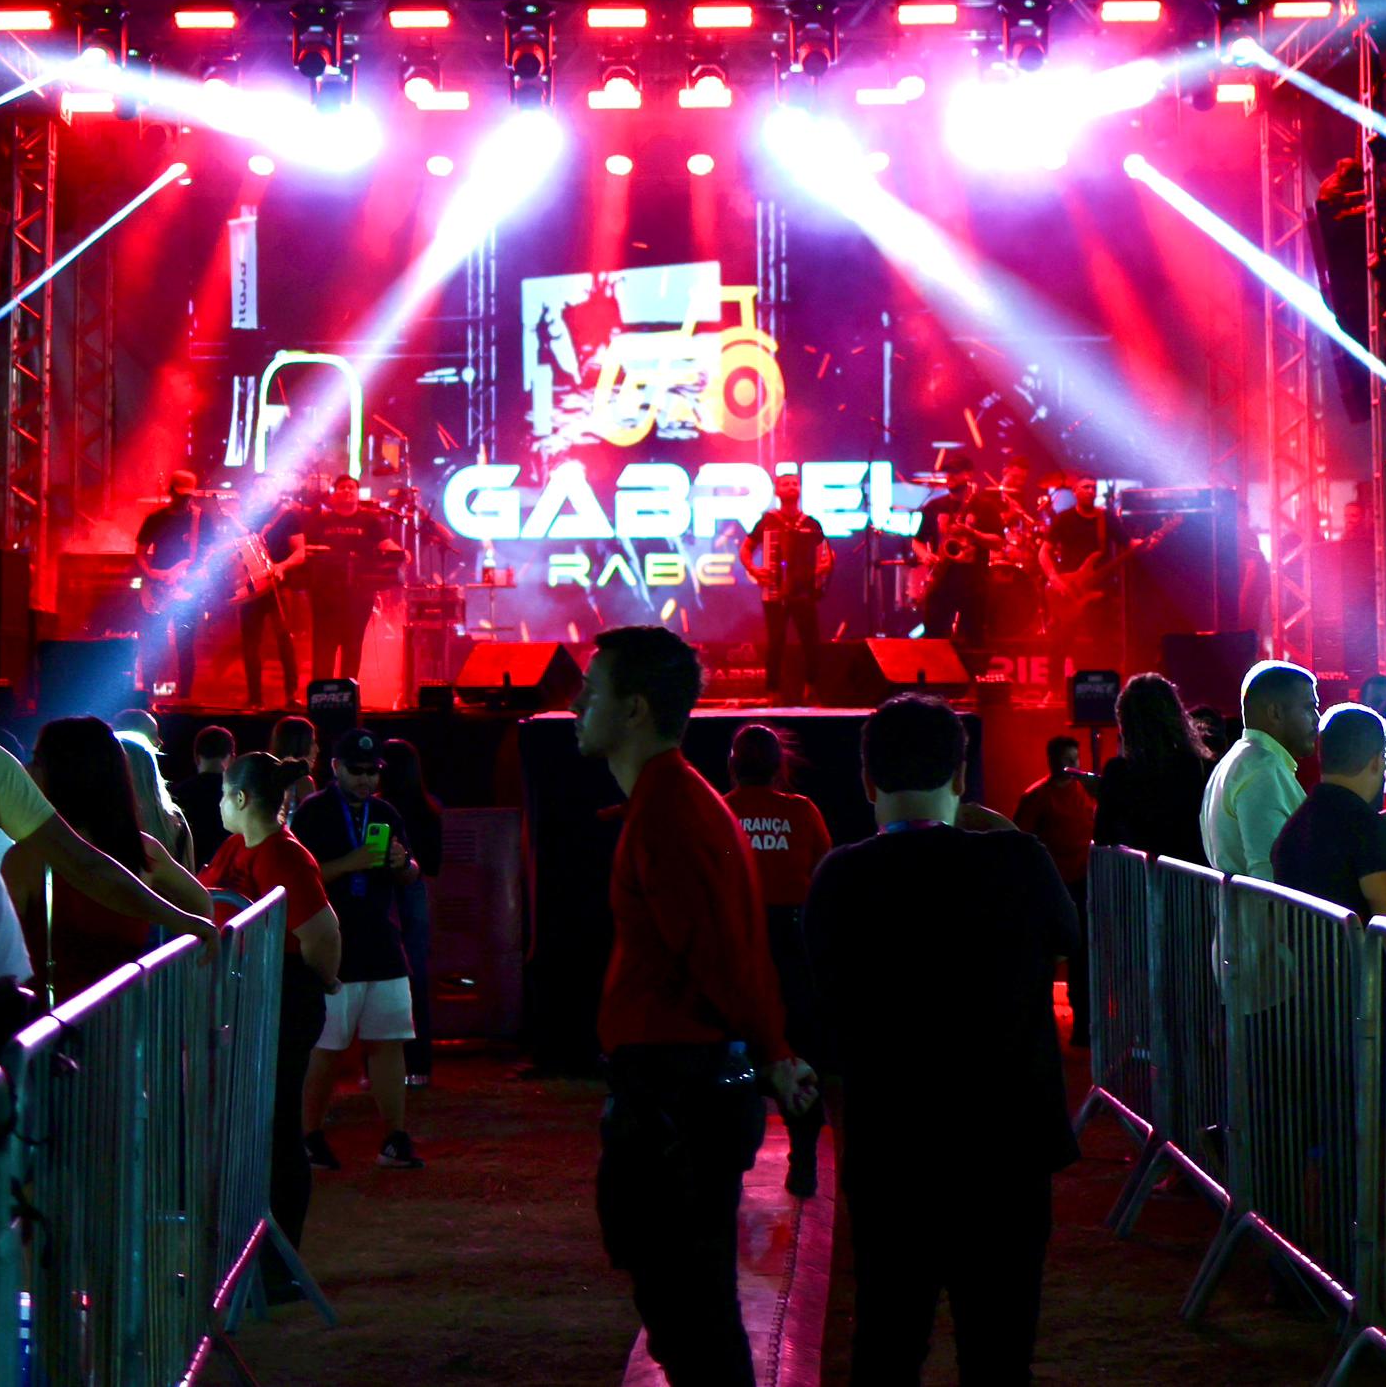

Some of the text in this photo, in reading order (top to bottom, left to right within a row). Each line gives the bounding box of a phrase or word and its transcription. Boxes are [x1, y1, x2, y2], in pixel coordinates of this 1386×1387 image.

[443, 460, 924, 540] GABREL
[548, 553, 736, 587] RABE
[739, 817, 792, 835] RANÇA
[747, 834, 790, 851] ADA
